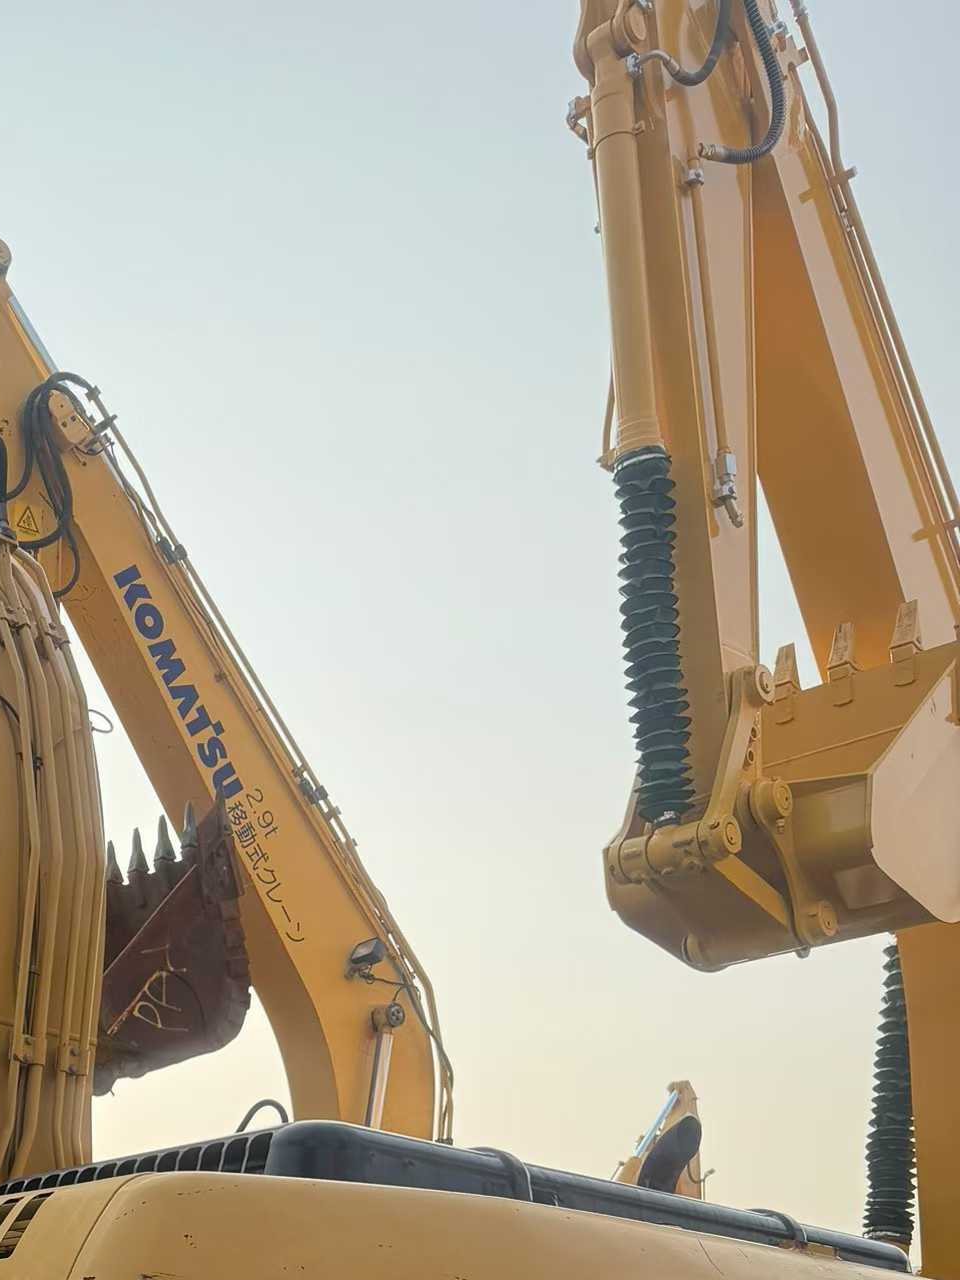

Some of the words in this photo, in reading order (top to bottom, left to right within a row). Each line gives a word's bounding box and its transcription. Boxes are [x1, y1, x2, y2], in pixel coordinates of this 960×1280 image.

[113, 564, 245, 799] KOMATSU
[227, 800, 305, 942] 移動式クレーン
[246, 788, 279, 840] 2.9t
